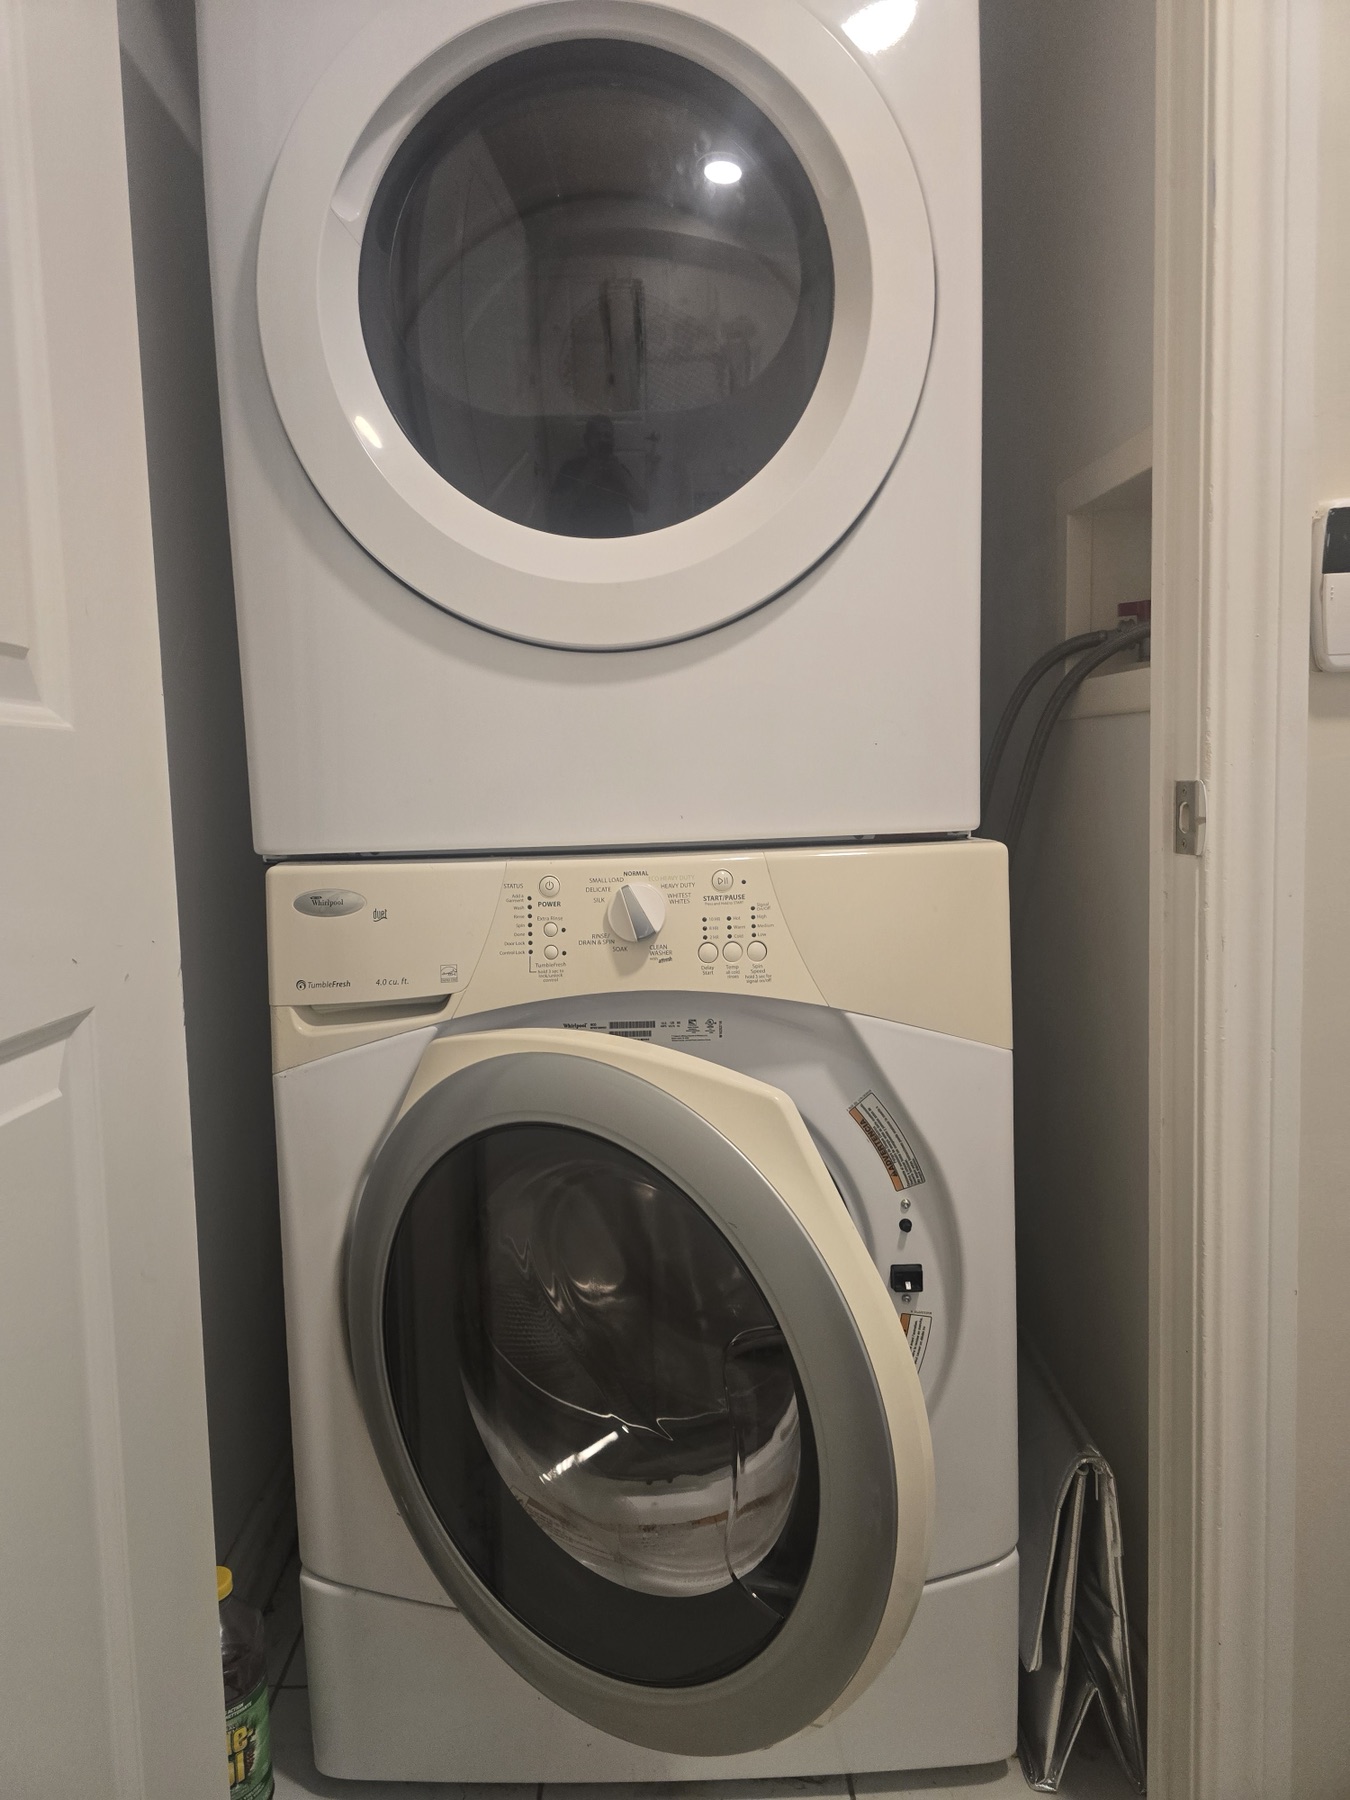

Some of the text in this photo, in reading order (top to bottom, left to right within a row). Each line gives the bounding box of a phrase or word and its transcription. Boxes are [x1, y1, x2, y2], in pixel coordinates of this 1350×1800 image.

[311, 899, 344, 907] Whirlpool
[373, 908, 387, 922] duet
[859, 1118, 896, 1172] ADVERTENCIA
